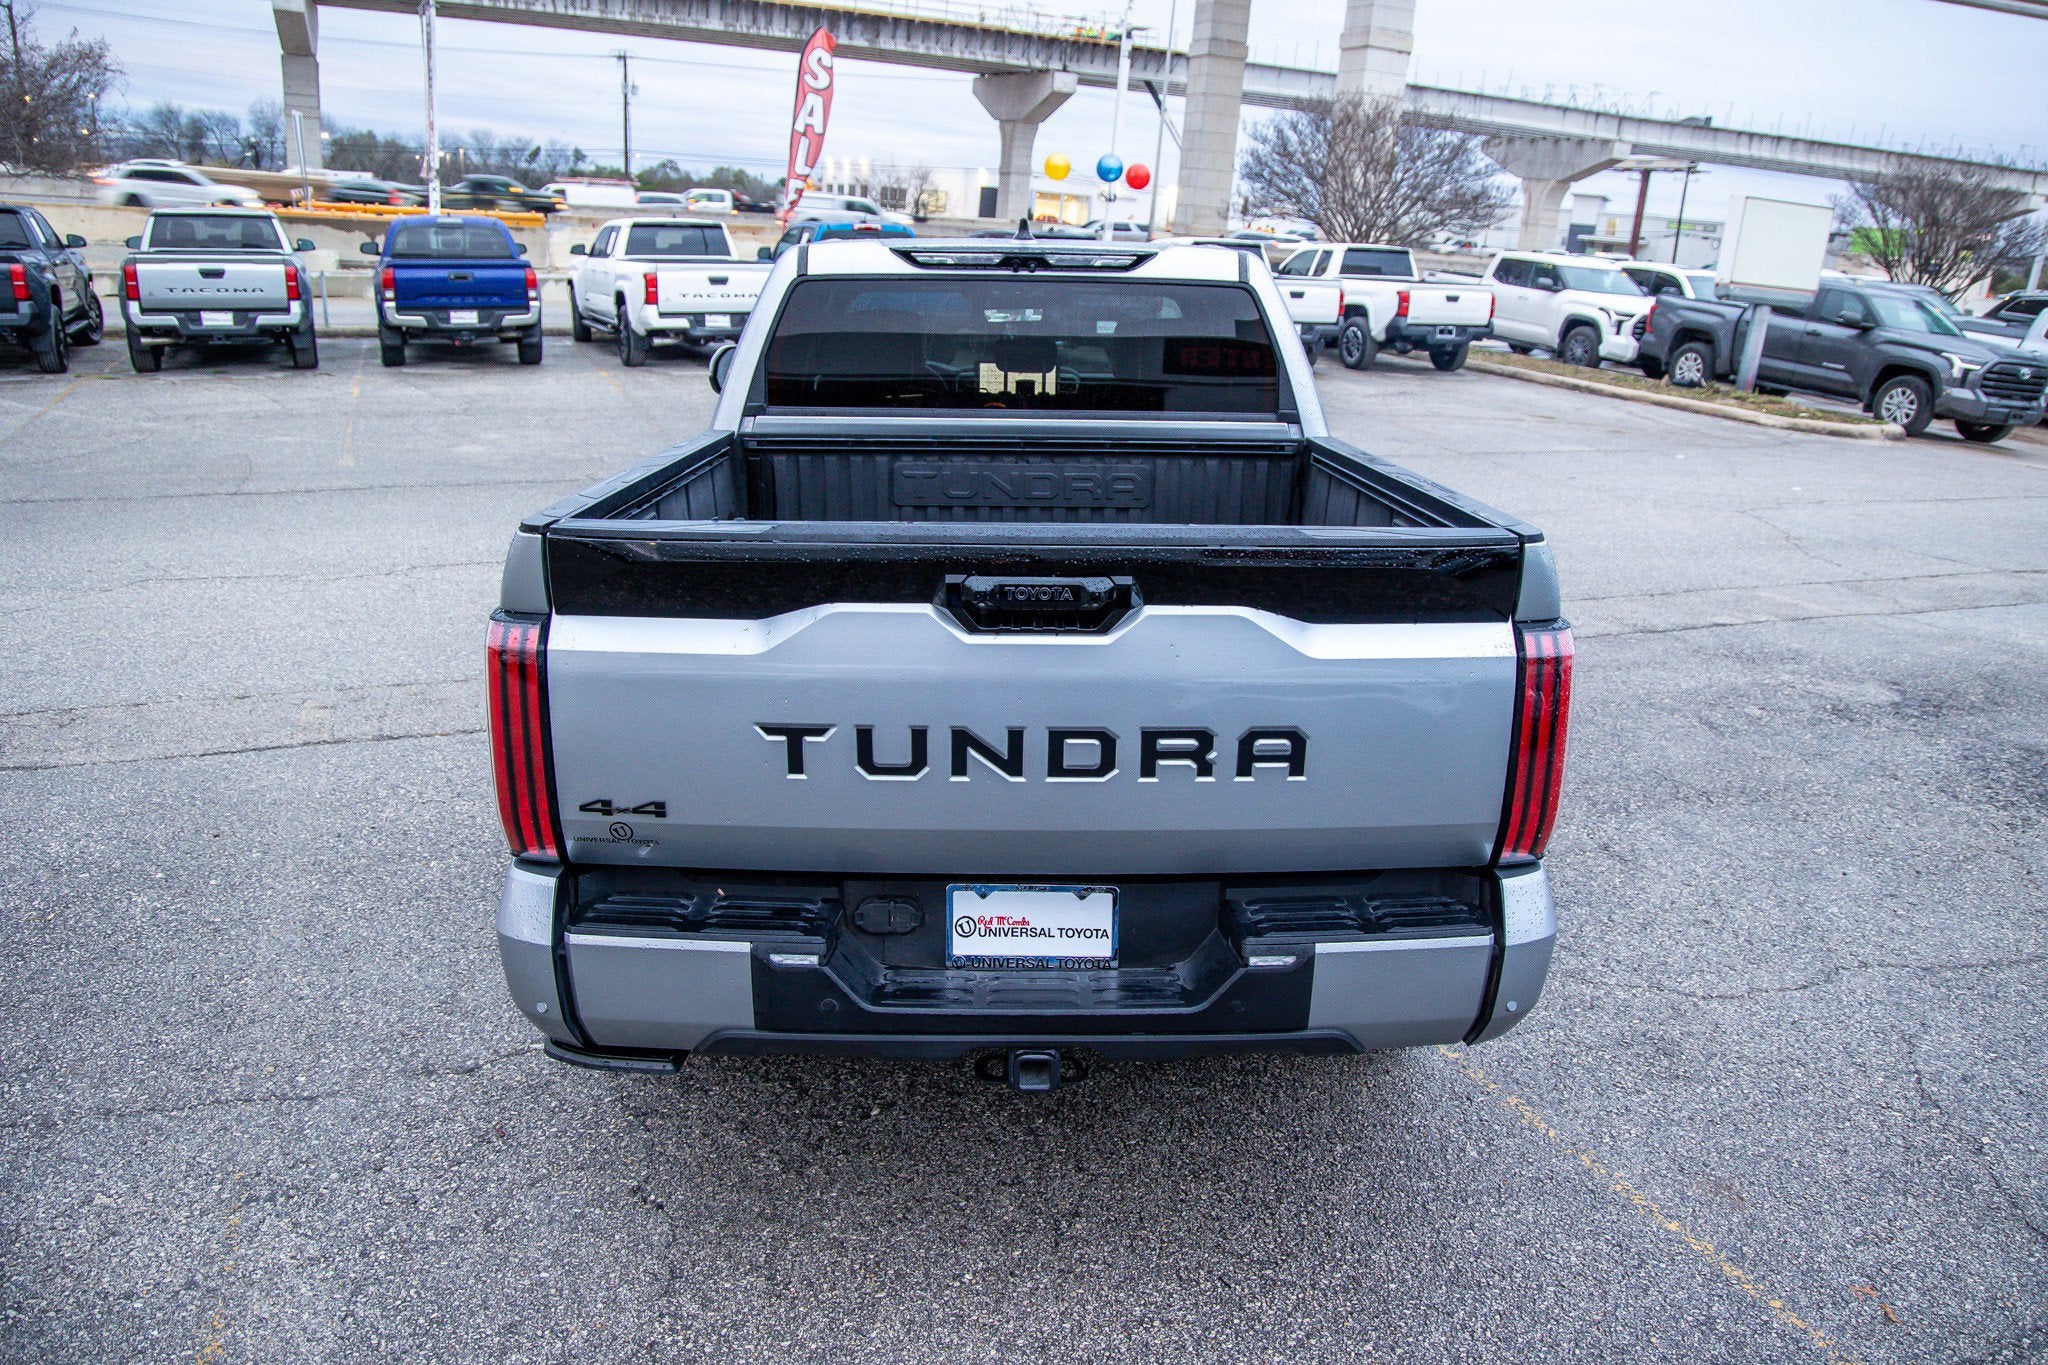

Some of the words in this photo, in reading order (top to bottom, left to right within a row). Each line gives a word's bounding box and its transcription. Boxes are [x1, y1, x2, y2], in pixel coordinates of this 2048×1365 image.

[901, 470, 1142, 500] TUNDRA
[1004, 586, 1074, 601] TOYOTA
[753, 722, 1310, 784] TUNDRA
[573, 836, 624, 845] UNIVERSAL
[977, 915, 994, 929] Red
[978, 927, 1055, 938] UNIVERSAL
[1057, 928, 1109, 939] TOYOTA
[971, 957, 1054, 969] UNIVERSAL
[1056, 957, 1112, 970] TOYOTA
